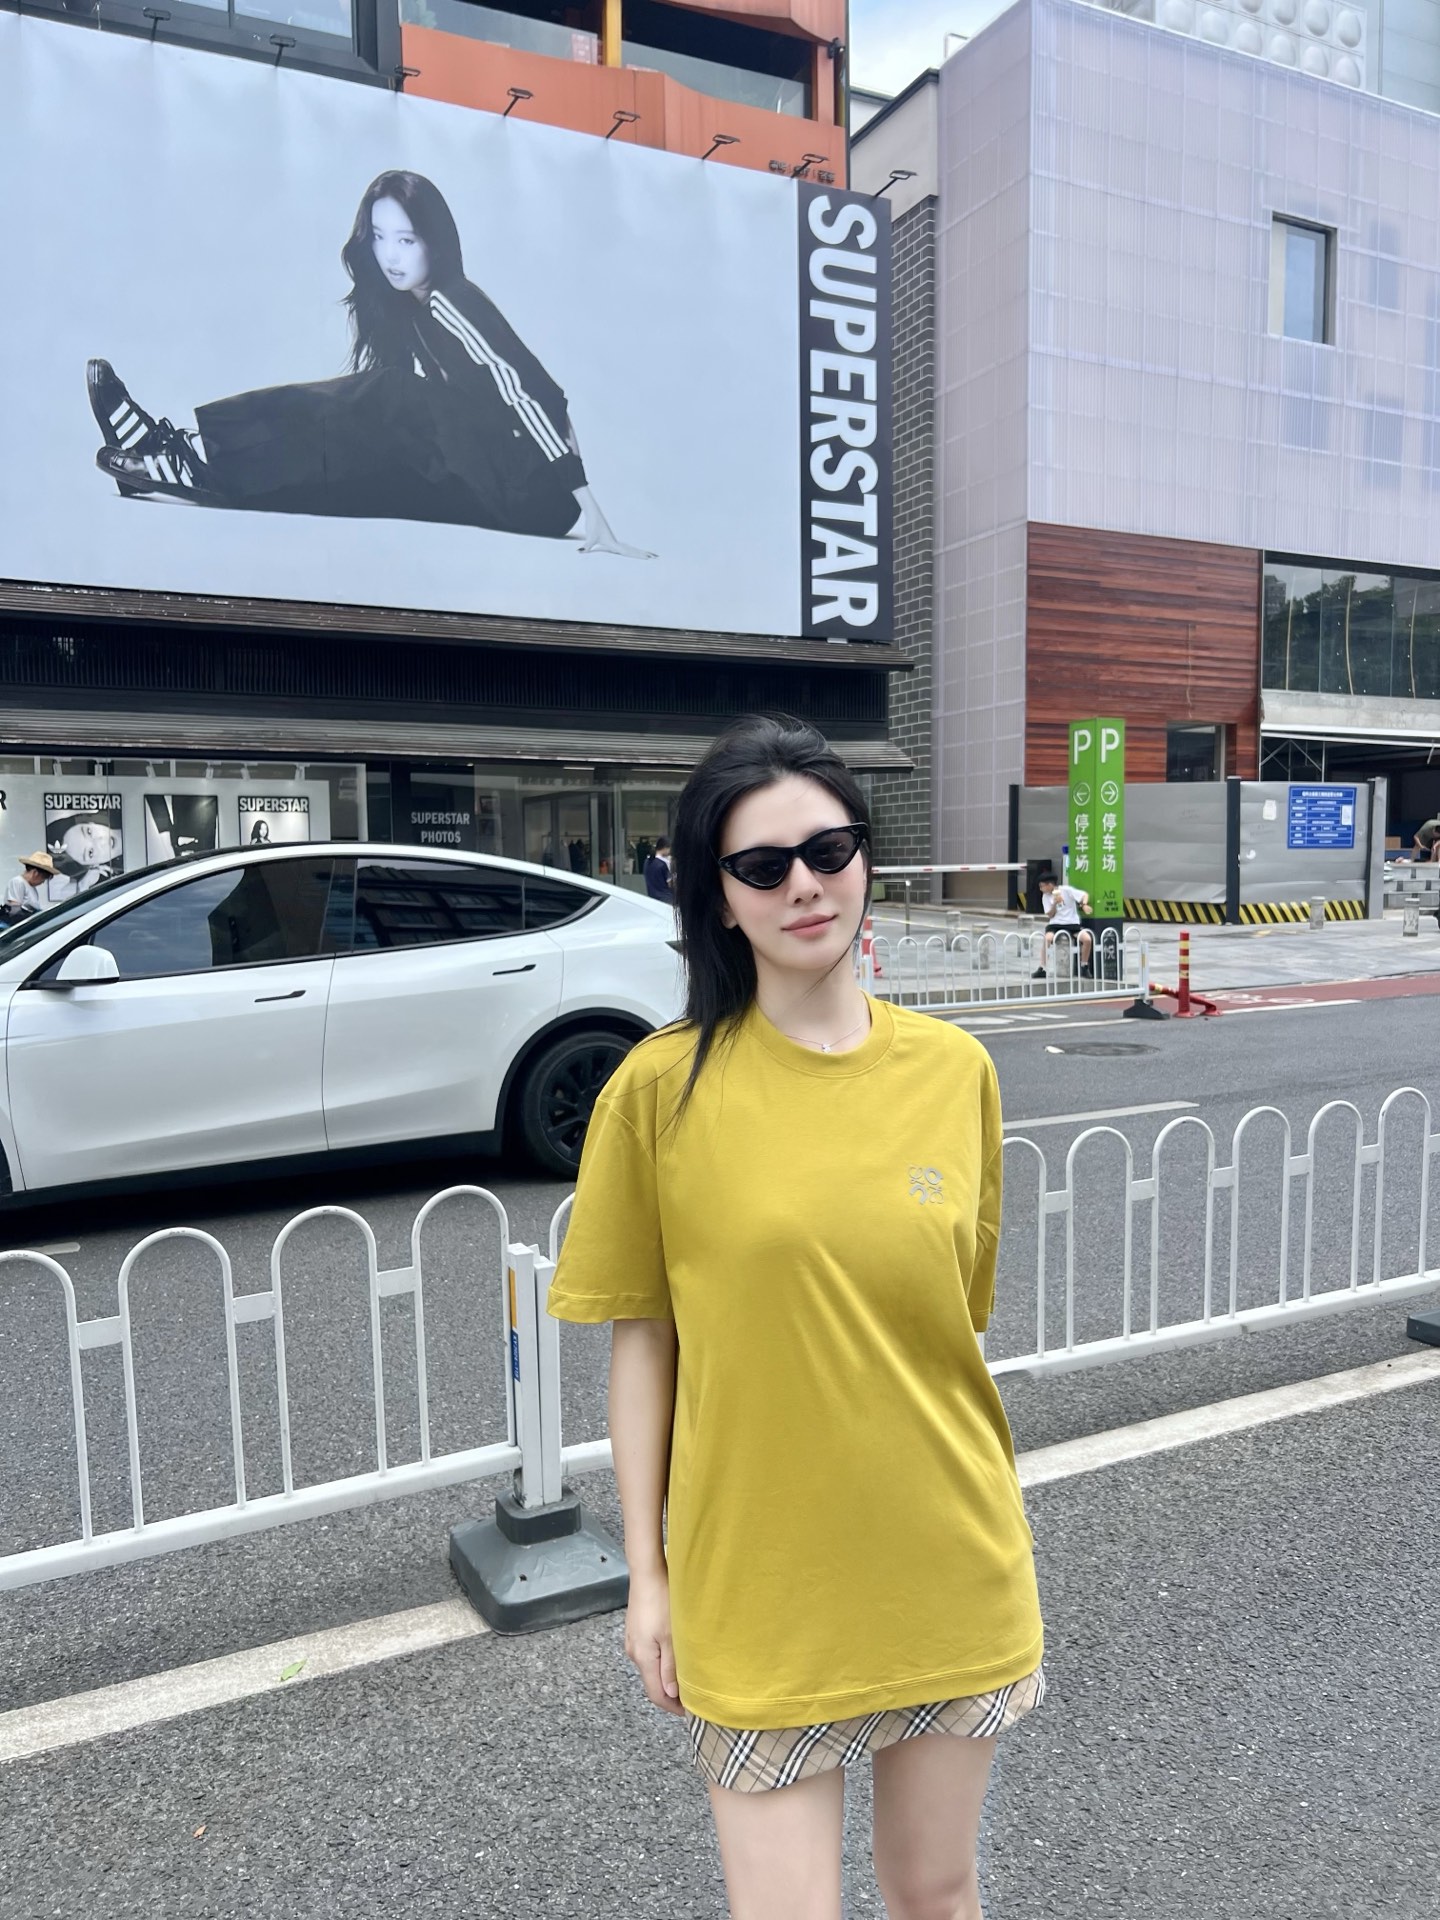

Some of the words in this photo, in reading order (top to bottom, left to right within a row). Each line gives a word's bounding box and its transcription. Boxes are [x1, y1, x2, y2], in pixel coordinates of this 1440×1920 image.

[808, 195, 878, 627] SUPERSTAR
[1074, 729, 1091, 765] P
[1101, 728, 1120, 763] P
[45, 794, 121, 809] SUPERSTAR
[239, 797, 309, 812] SUPERSTAR
[411, 812, 470, 825] SUPERSTAR
[421, 830, 461, 843] PHOTOS
[1075, 813, 1090, 873] 停车场
[1102, 812, 1117, 873] 停车场
[1103, 890, 1116, 899] 入口
